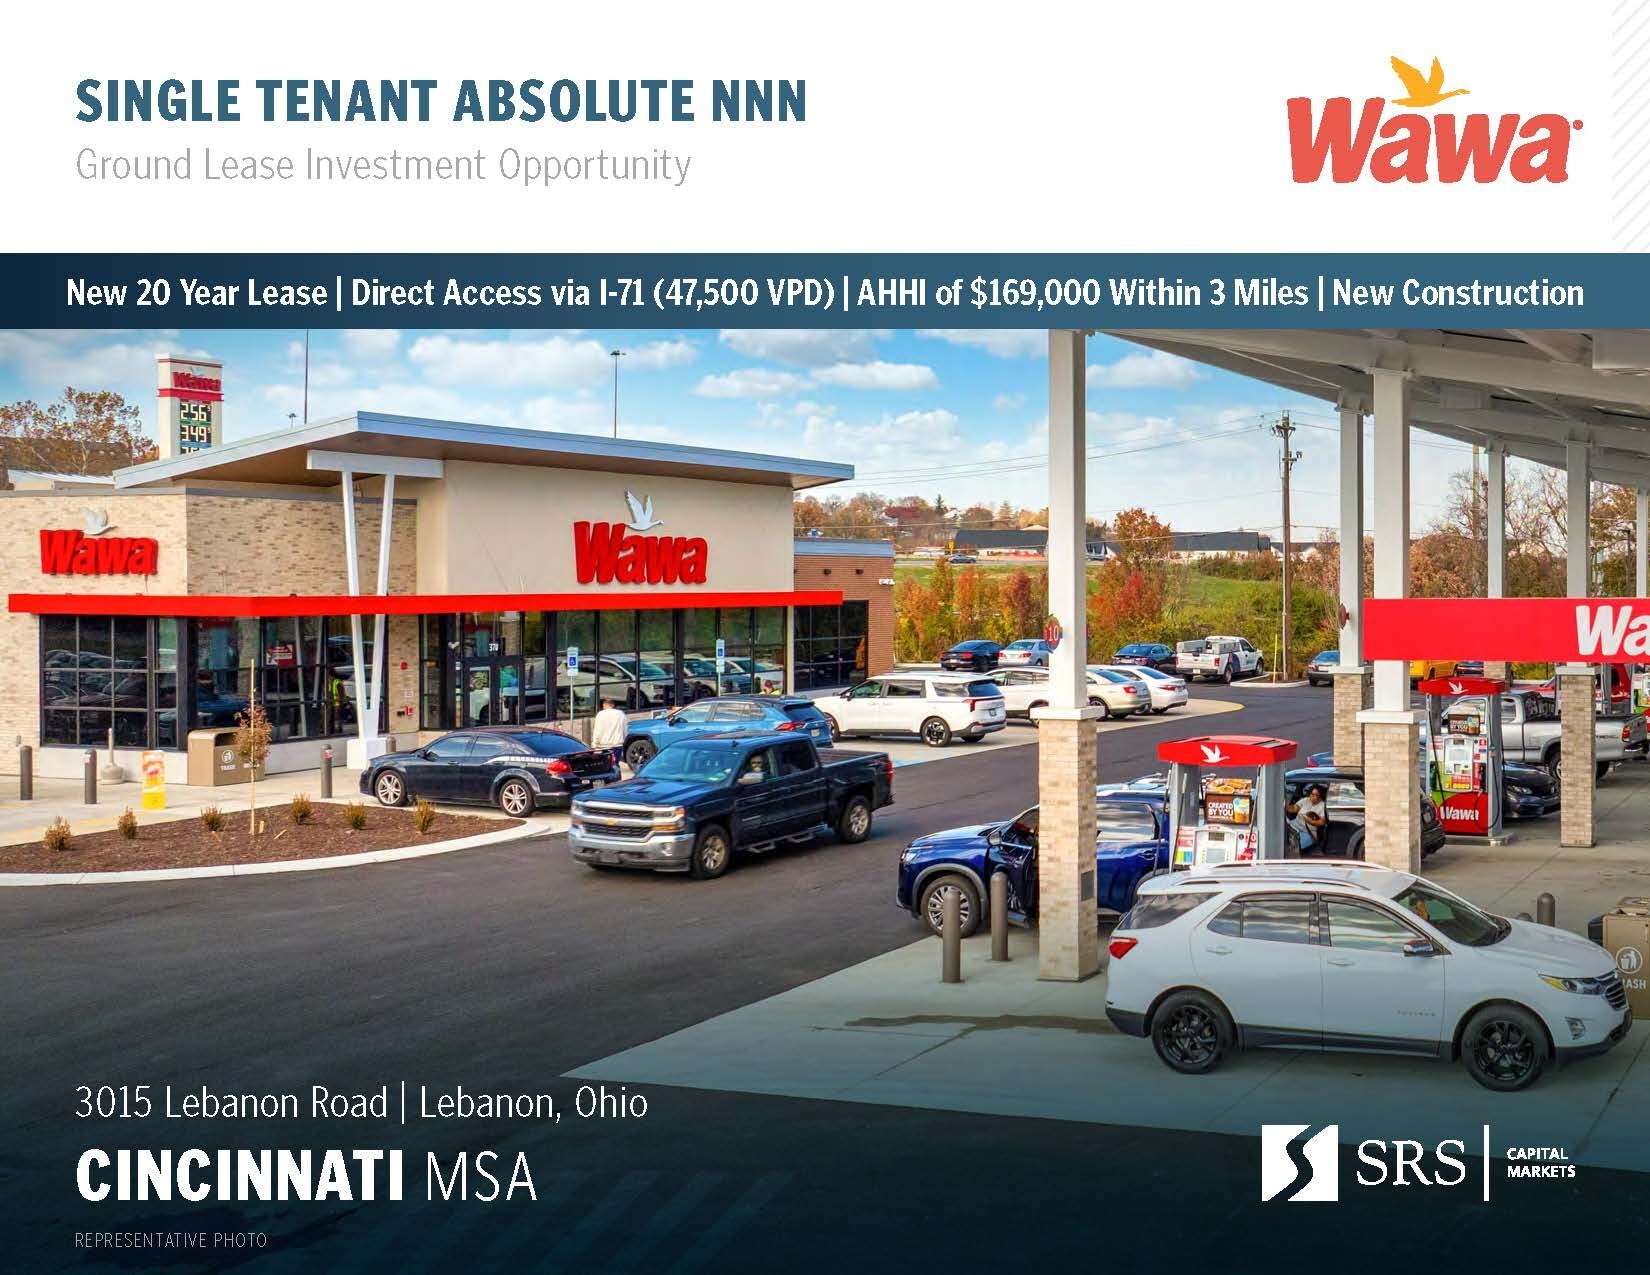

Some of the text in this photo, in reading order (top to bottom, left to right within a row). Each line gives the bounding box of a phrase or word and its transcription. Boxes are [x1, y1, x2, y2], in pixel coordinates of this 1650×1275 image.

[39, 529, 158, 576] Wawa
[573, 520, 708, 584] Wawa
[1575, 605, 1650, 657] Wa
[1208, 801, 1233, 810] CREATED
[1208, 809, 1233, 817] BY YOU
[1440, 806, 1479, 820] Wawa
[1623, 979, 1647, 989] ASH
